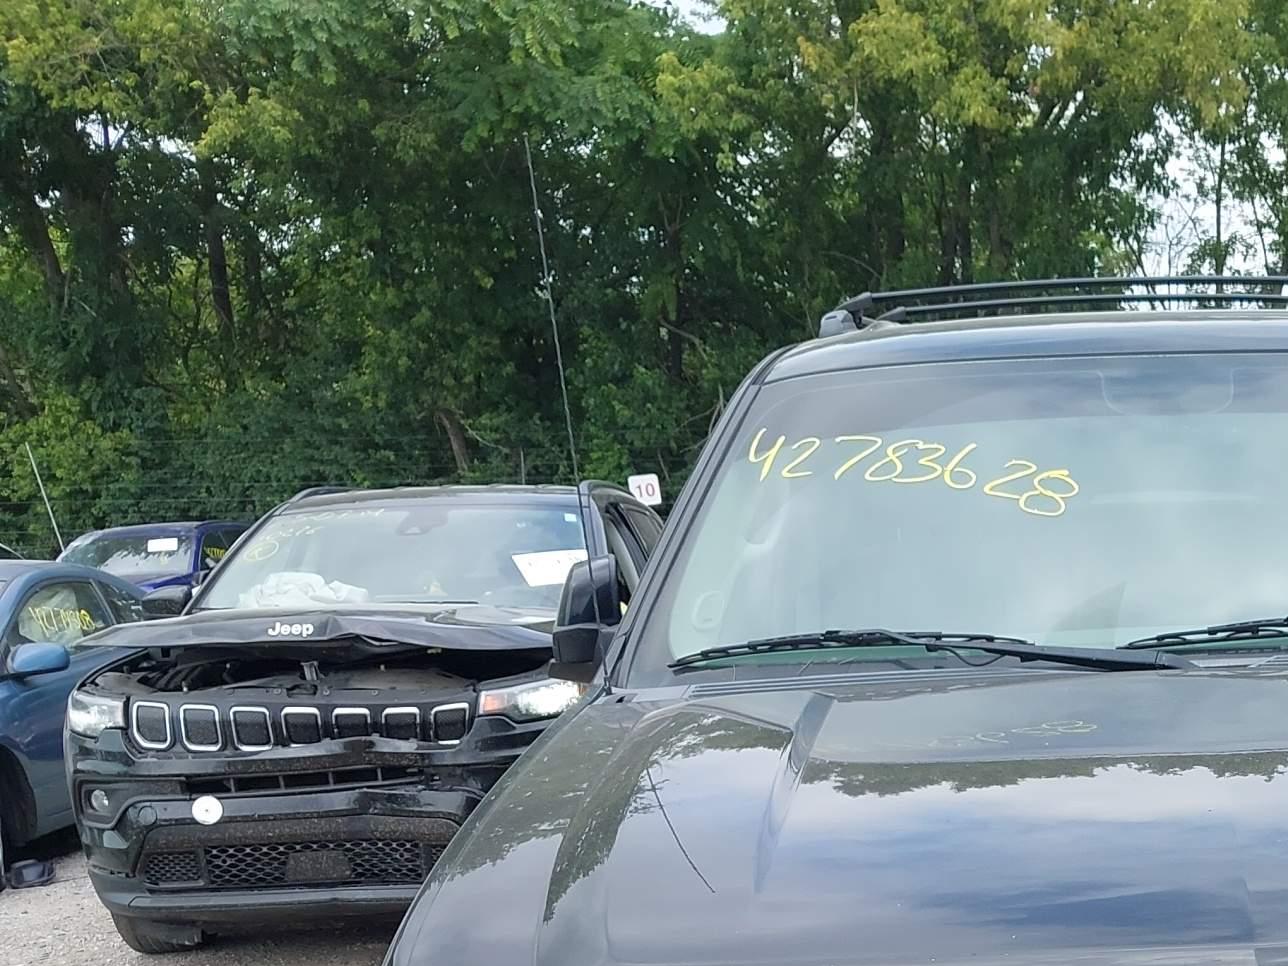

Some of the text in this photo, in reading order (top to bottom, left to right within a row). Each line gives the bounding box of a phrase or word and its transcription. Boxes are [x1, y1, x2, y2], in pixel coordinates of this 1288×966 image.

[749, 428, 1079, 516] 42783628
[636, 483, 655, 498] 10
[267, 621, 314, 638] Jeep
